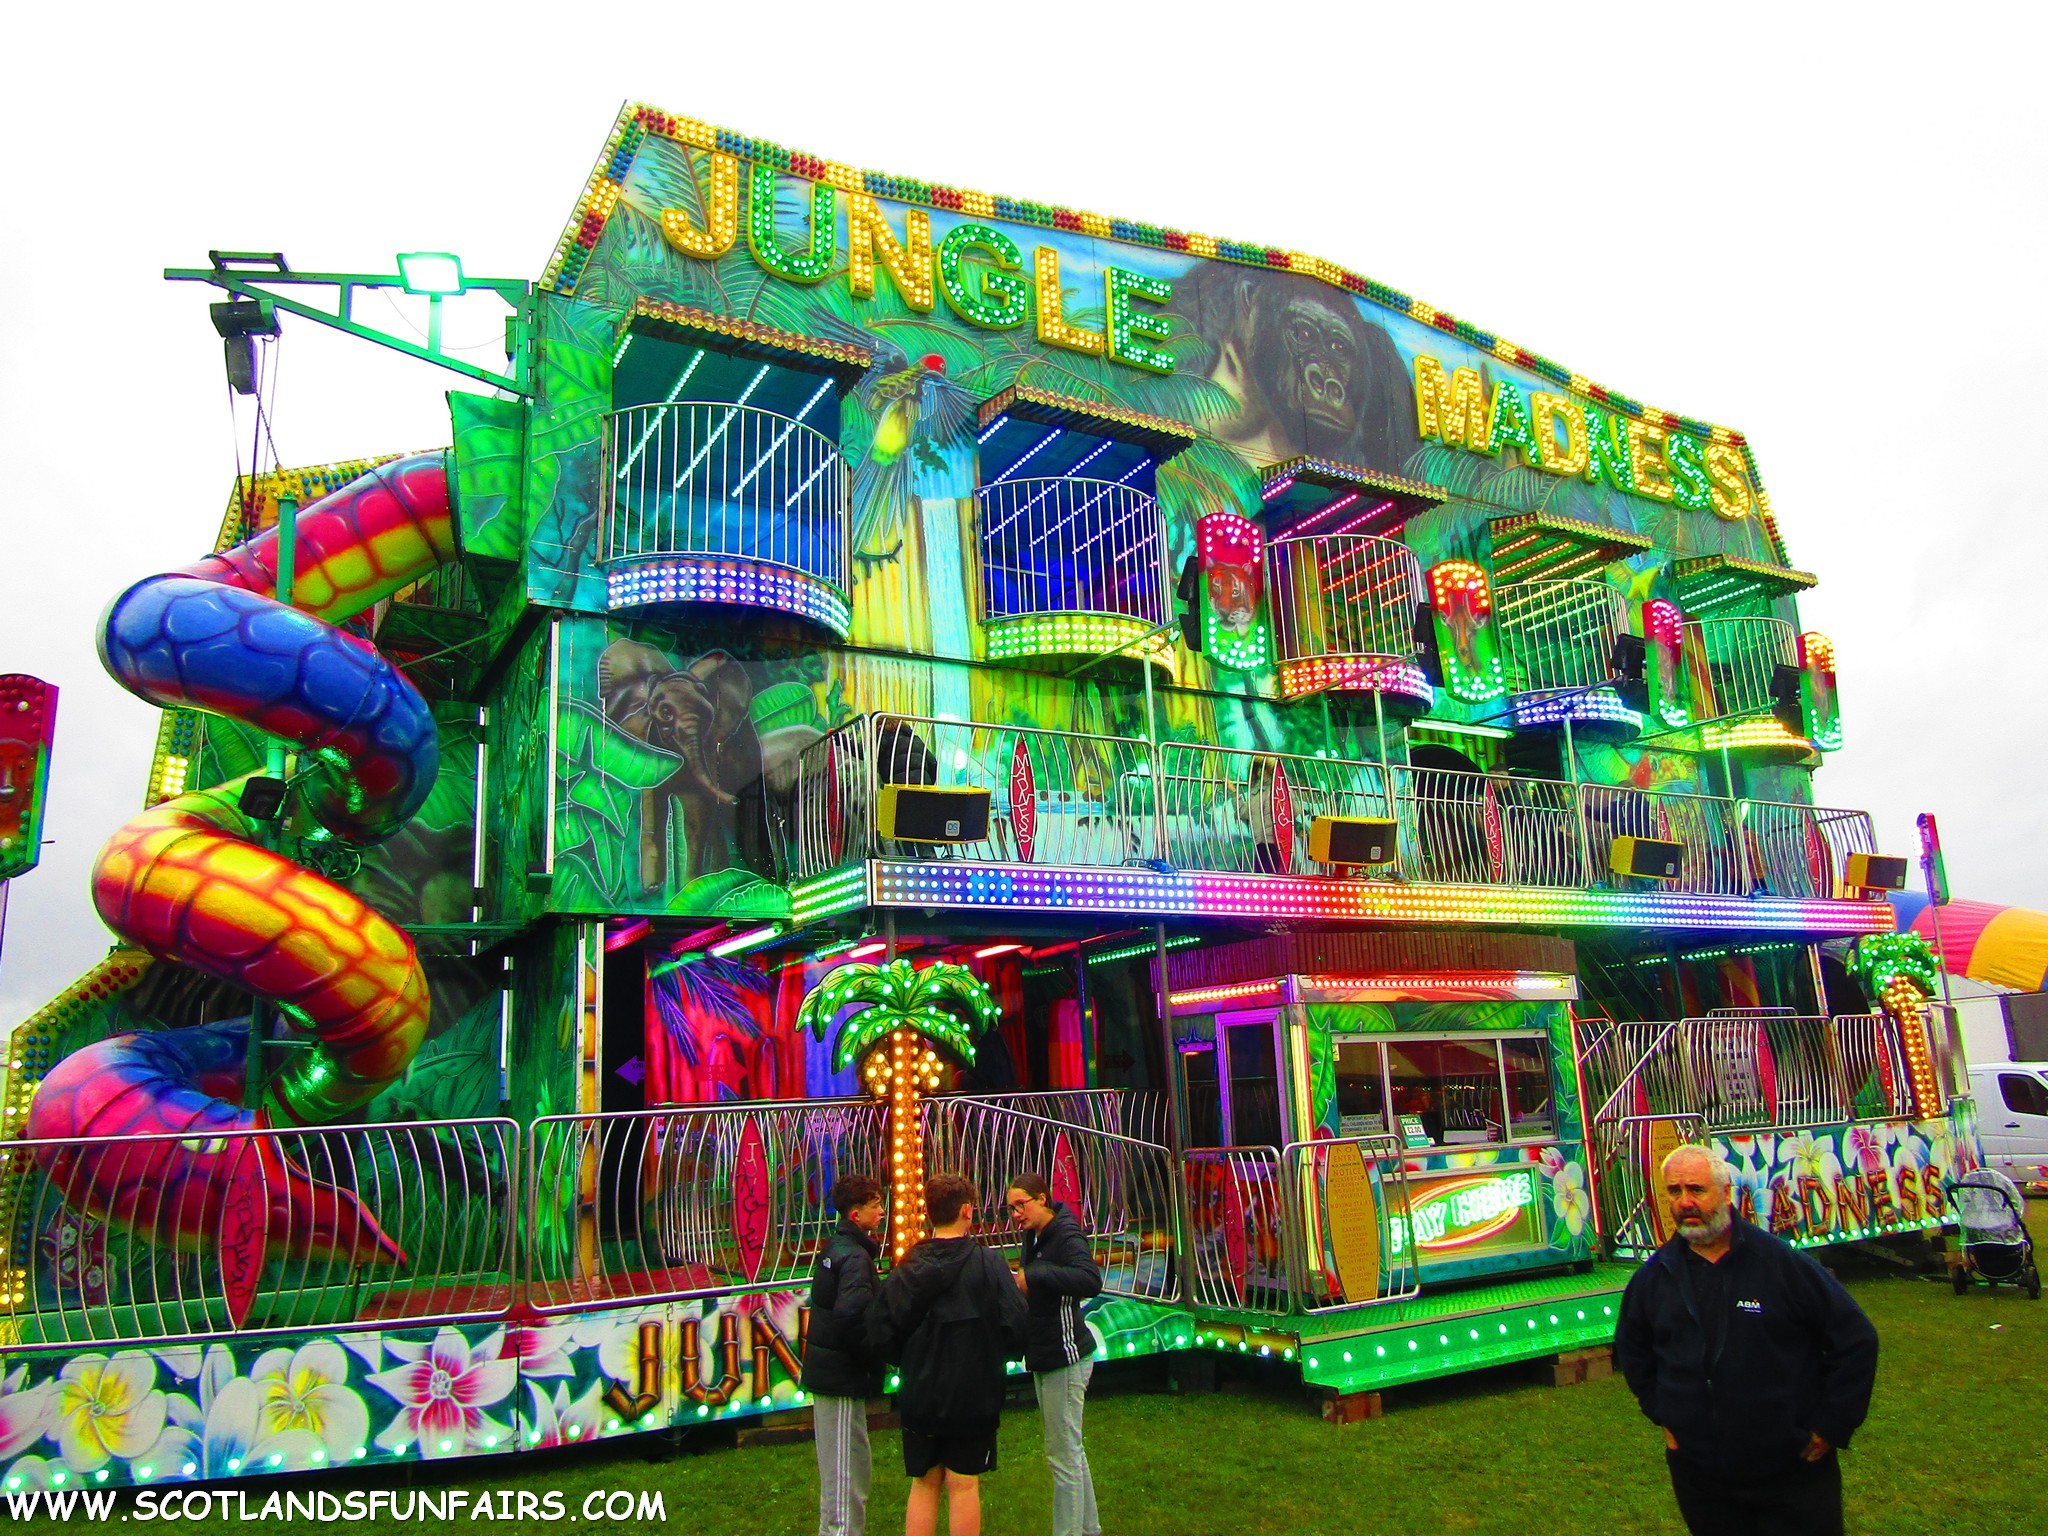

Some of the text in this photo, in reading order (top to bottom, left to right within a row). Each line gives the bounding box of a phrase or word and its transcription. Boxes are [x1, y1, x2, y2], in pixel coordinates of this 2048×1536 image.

[661, 152, 1176, 376] JUNGLE
[1413, 354, 1752, 520] MADNESS
[1012, 753, 1034, 843] MADNESS
[737, 1142, 768, 1250] JUNGLE
[1333, 1154, 1356, 1162] ENTRY
[1333, 1168, 1362, 1177] NOTICE
[602, 1306, 811, 1422] JUN
